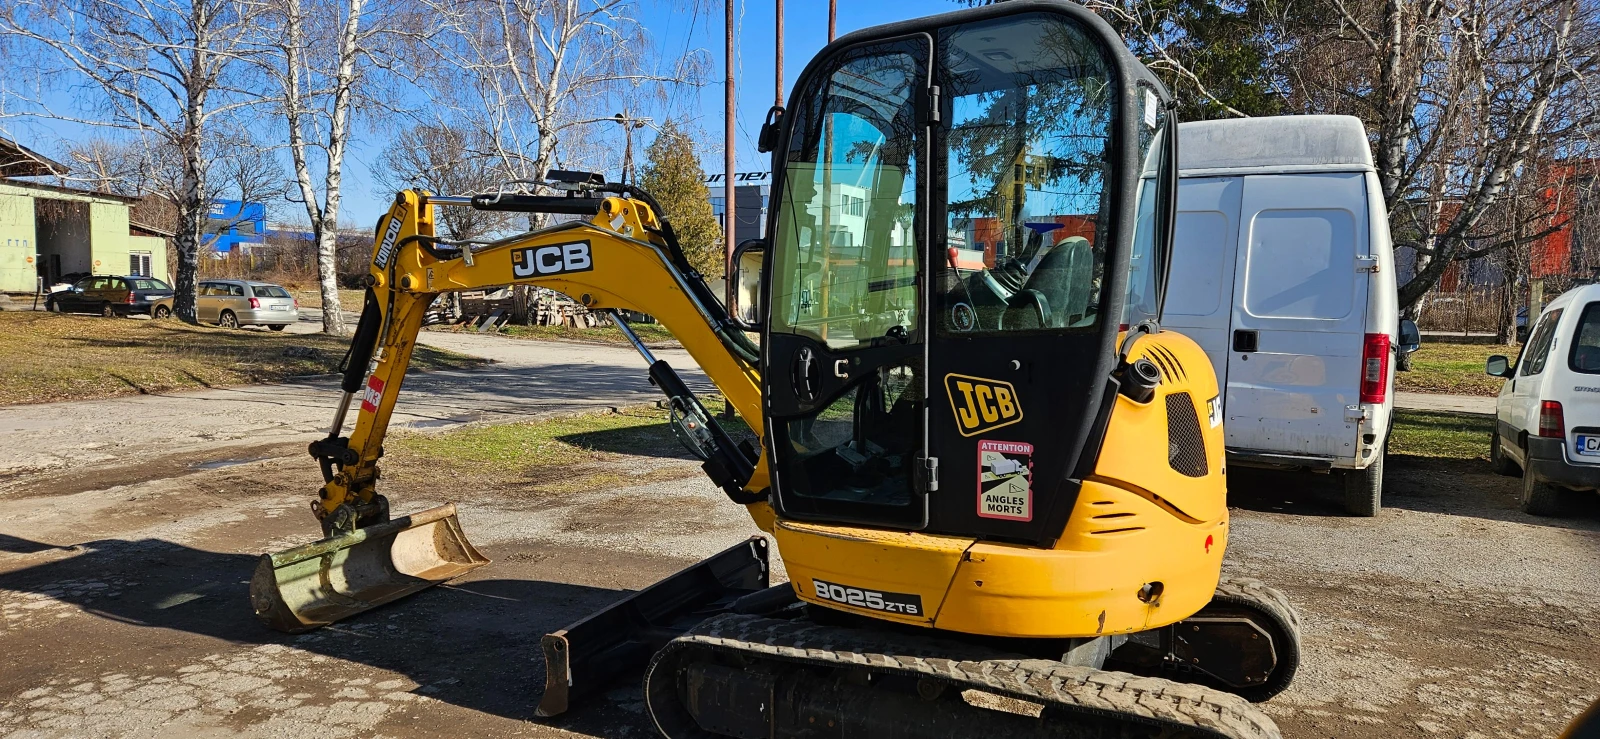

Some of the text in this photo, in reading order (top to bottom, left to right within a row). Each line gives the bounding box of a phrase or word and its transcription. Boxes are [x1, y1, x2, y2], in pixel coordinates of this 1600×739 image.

[514, 243, 591, 276] JCB
[956, 380, 1015, 429] JCB
[981, 442, 1030, 453] ATTENTION
[985, 494, 1025, 505] ANGLES
[987, 503, 1023, 515] MORTS
